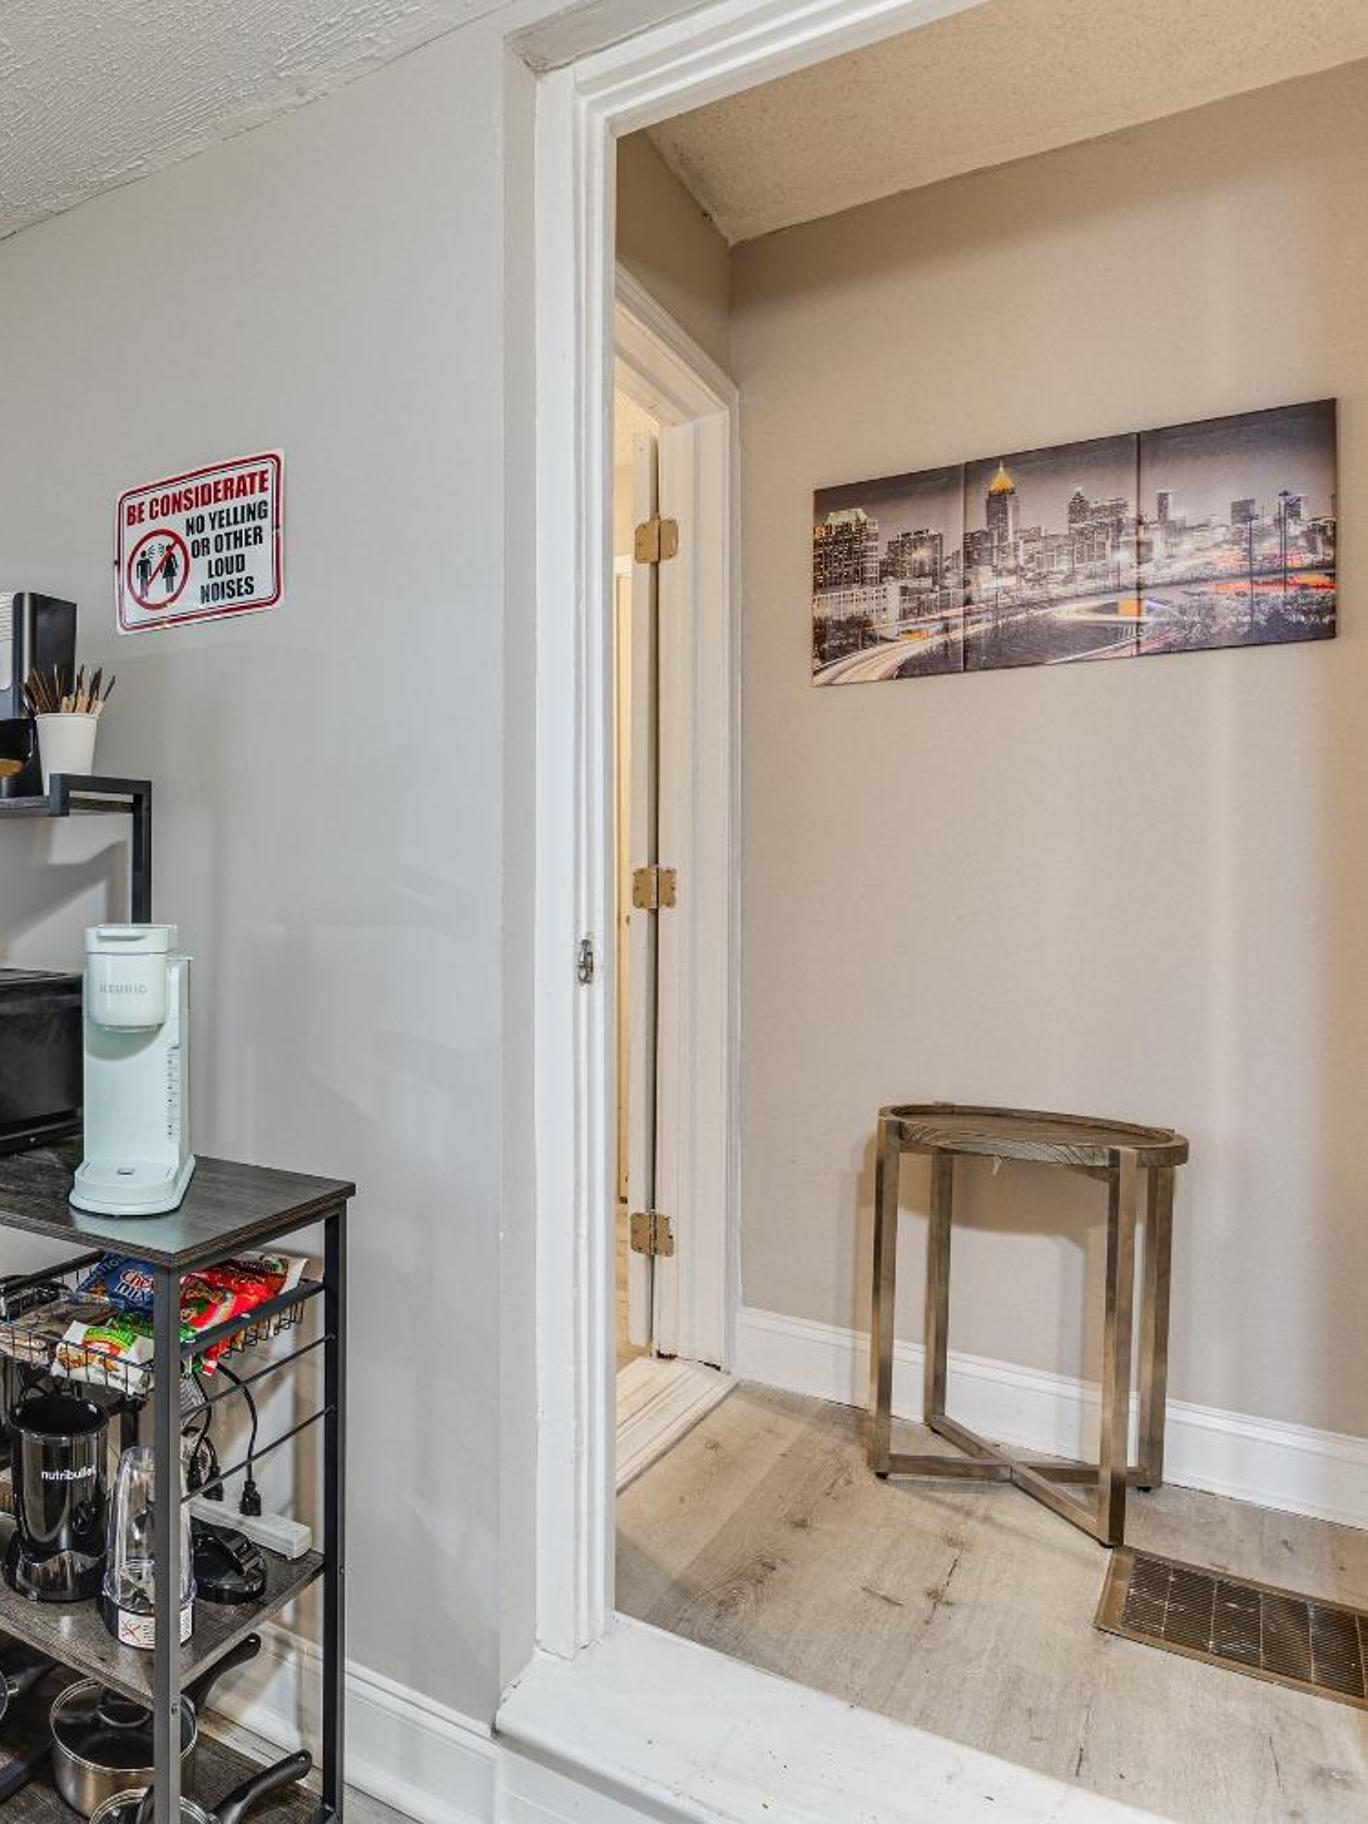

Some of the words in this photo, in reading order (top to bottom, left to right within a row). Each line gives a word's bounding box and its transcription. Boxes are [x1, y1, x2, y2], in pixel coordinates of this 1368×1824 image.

[126, 502, 145, 526] BE
[148, 469, 270, 520] CONSIDERATE
[185, 514, 206, 537] NO
[208, 500, 269, 531] YELLING
[191, 537, 212, 559] OR
[214, 526, 264, 554] OTHER
[207, 553, 246, 579] LOUD
[200, 576, 255, 604] NOISES
[99, 983, 148, 994] KEURIG
[41, 1464, 96, 1480] nutribullet
